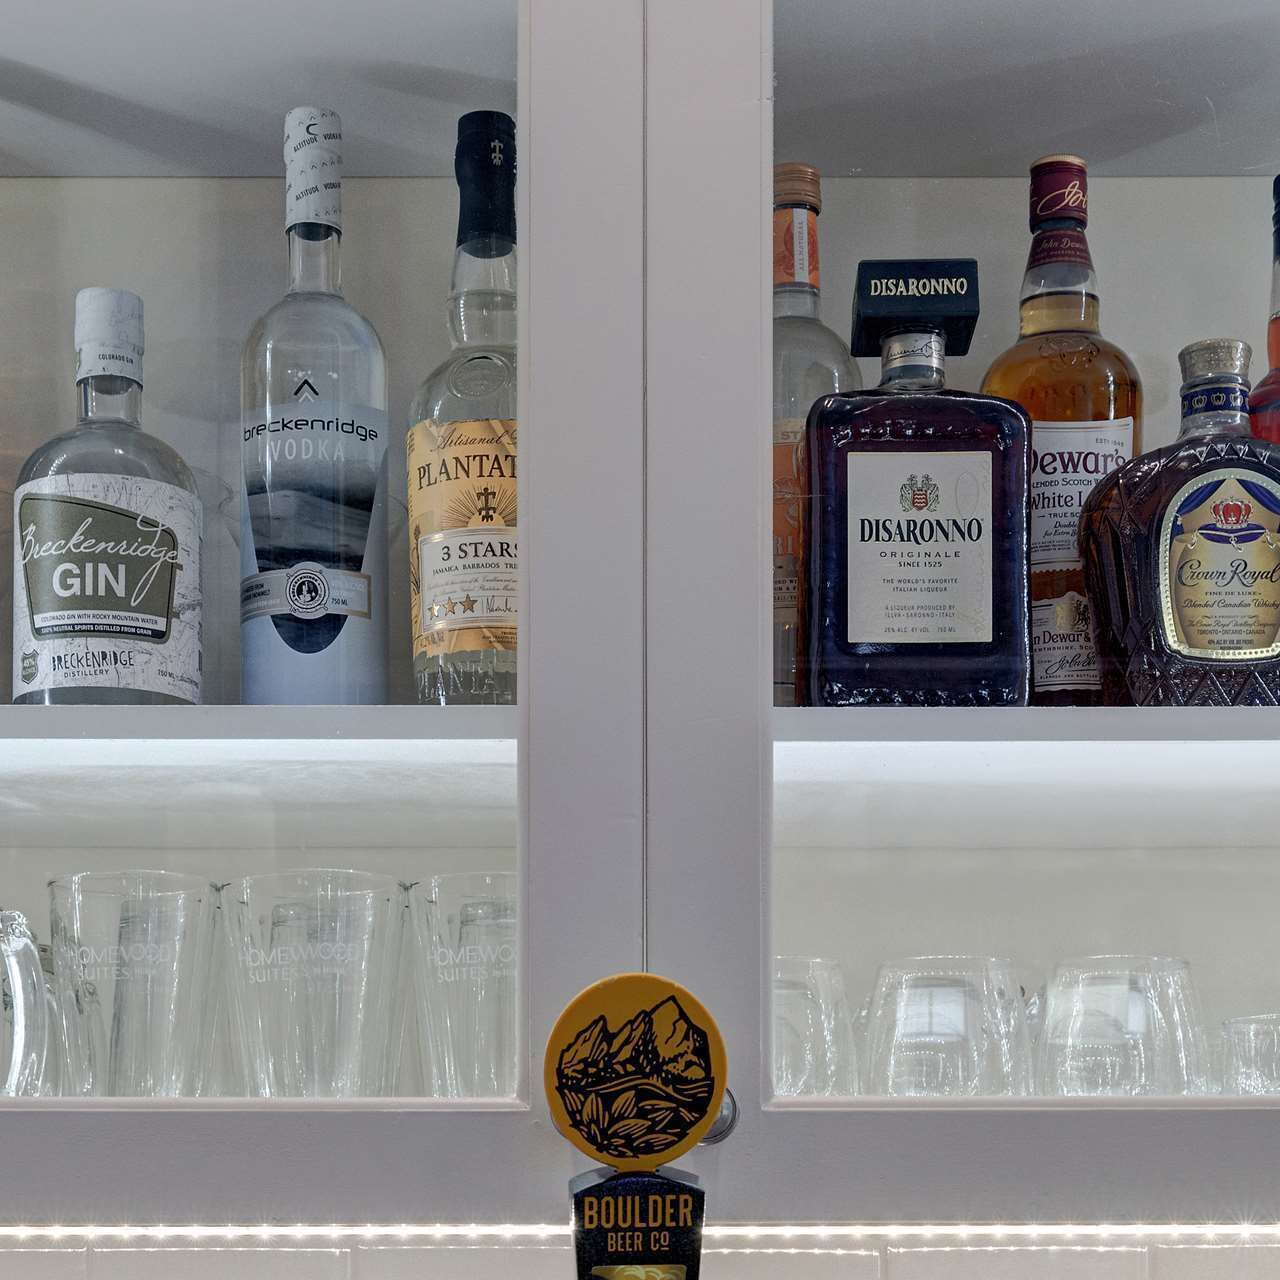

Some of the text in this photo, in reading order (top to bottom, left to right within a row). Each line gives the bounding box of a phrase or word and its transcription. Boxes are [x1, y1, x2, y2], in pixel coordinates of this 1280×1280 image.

[293, 136, 318, 152] ALTITUDE
[295, 185, 320, 201] ALTITUDE
[870, 278, 968, 297] DISARONNO
[244, 418, 378, 442] breckenridge
[440, 427, 506, 450] Artisanal
[270, 438, 345, 462] VODKA
[1061, 478, 1092, 487] SCOTCH
[860, 518, 983, 546] DISARONNO
[22, 514, 179, 607] Breckenridge
[442, 545, 450, 562] 3
[432, 564, 459, 576] JAMAICA
[462, 562, 500, 570] BARBADOS
[1178, 558, 1226, 587] Crown
[52, 562, 126, 598] GIN
[1182, 598, 1216, 609] Blended
[1216, 598, 1252, 609] Canadian
[92, 612, 110, 620] ROCKY
[111, 614, 140, 624] MOUNTAIN
[141, 617, 158, 626] WATER
[94, 624, 120, 632] DISTILLED
[1042, 630, 1091, 644] Dewar &
[52, 650, 134, 672] BRECKENRIDGE
[64, 668, 110, 678] DISTILLERY
[240, 943, 360, 966] HOMEWOOD
[248, 966, 300, 984] SUITES
[436, 967, 489, 984] SUITES
[582, 1194, 694, 1230] BOULDER
[607, 1232, 642, 1252] BEER
